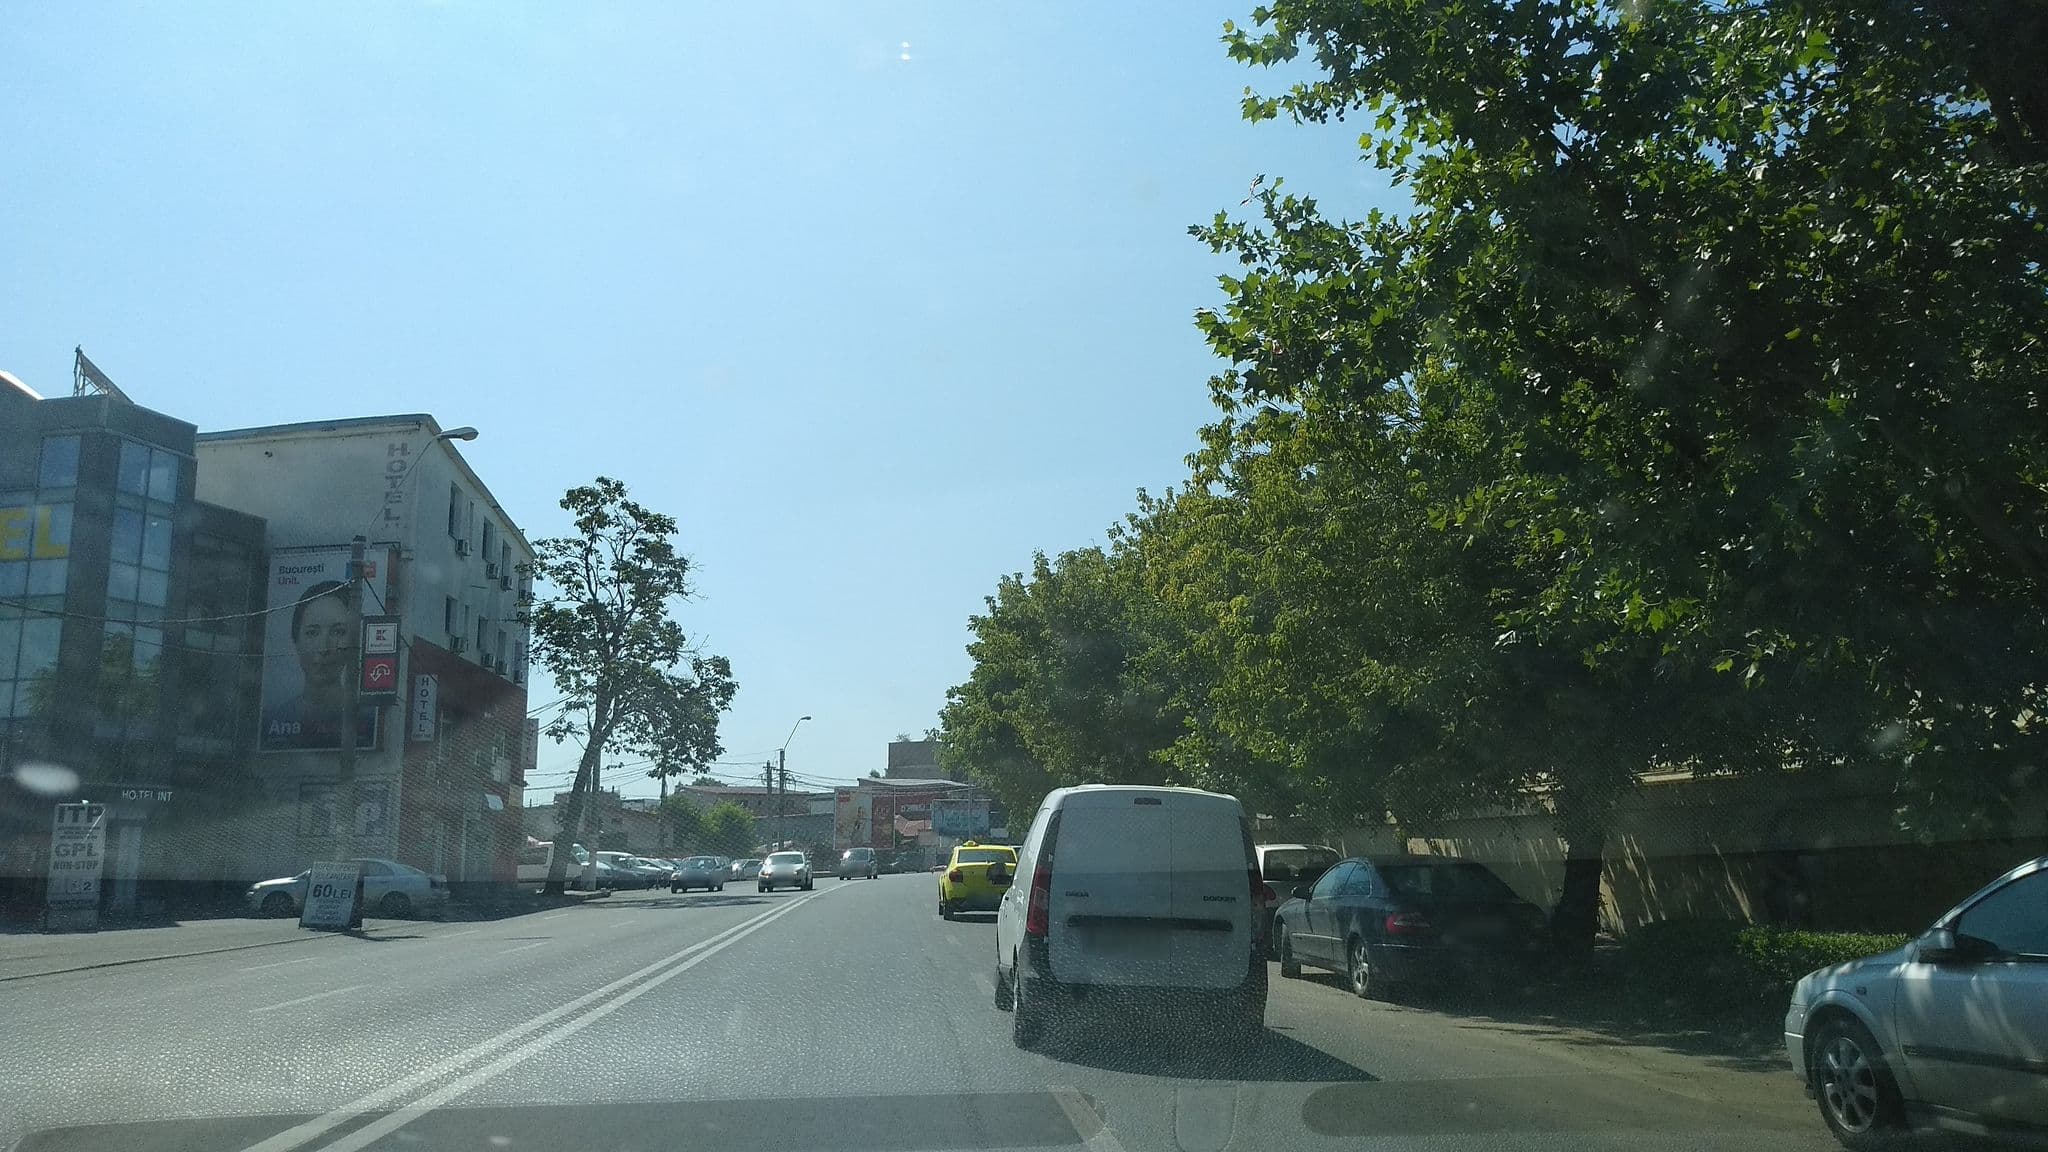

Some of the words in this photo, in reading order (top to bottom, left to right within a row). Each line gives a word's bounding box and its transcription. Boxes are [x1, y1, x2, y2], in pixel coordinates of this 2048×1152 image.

[385, 443, 408, 520] HOTEL
[420, 677, 429, 732] HOTEL
[269, 720, 302, 735] Ana
[58, 806, 104, 823] ITP
[55, 843, 98, 857] GPL
[53, 861, 99, 870] NON-STOP
[313, 884, 333, 898] 60
[333, 889, 352, 899] LEI
